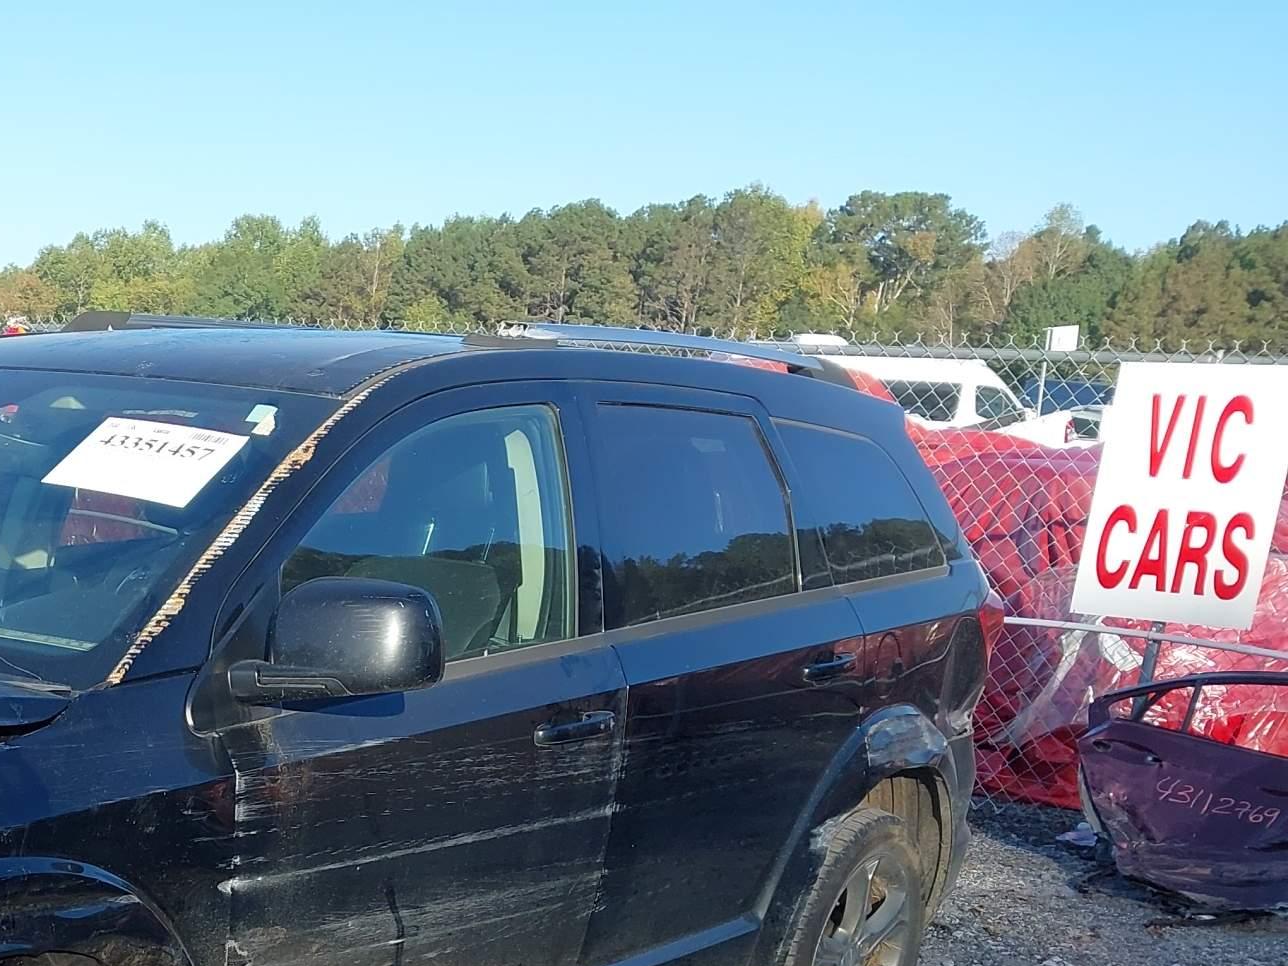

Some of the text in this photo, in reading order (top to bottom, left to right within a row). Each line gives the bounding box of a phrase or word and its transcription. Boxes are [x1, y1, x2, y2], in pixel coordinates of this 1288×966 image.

[99, 433, 216, 461] 43351457
[1149, 393, 1254, 484] VIC
[1095, 504, 1256, 601] CARS
[1156, 776, 1281, 828] 43112769
